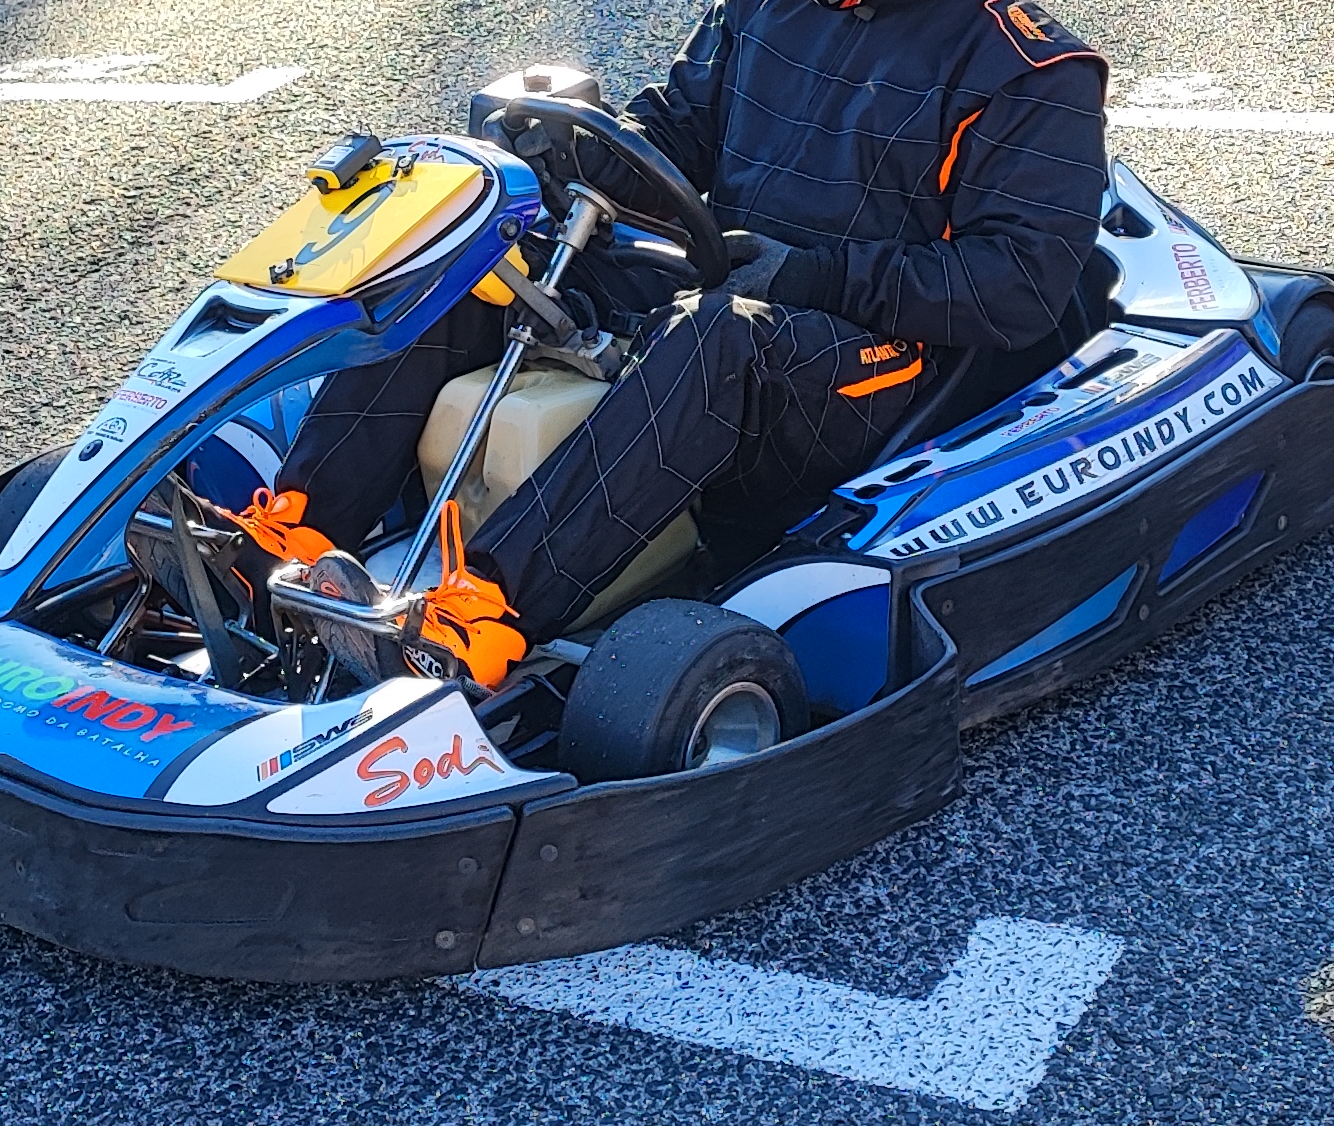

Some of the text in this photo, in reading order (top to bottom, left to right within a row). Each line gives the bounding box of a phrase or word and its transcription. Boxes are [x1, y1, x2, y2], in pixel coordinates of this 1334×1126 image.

[295, 179, 397, 266] 9
[1171, 243, 1220, 312] FERBERTO
[45, 716, 70, 731] DA
[76, 727, 160, 768] BATALHA
[356, 734, 506, 808] Sodi
